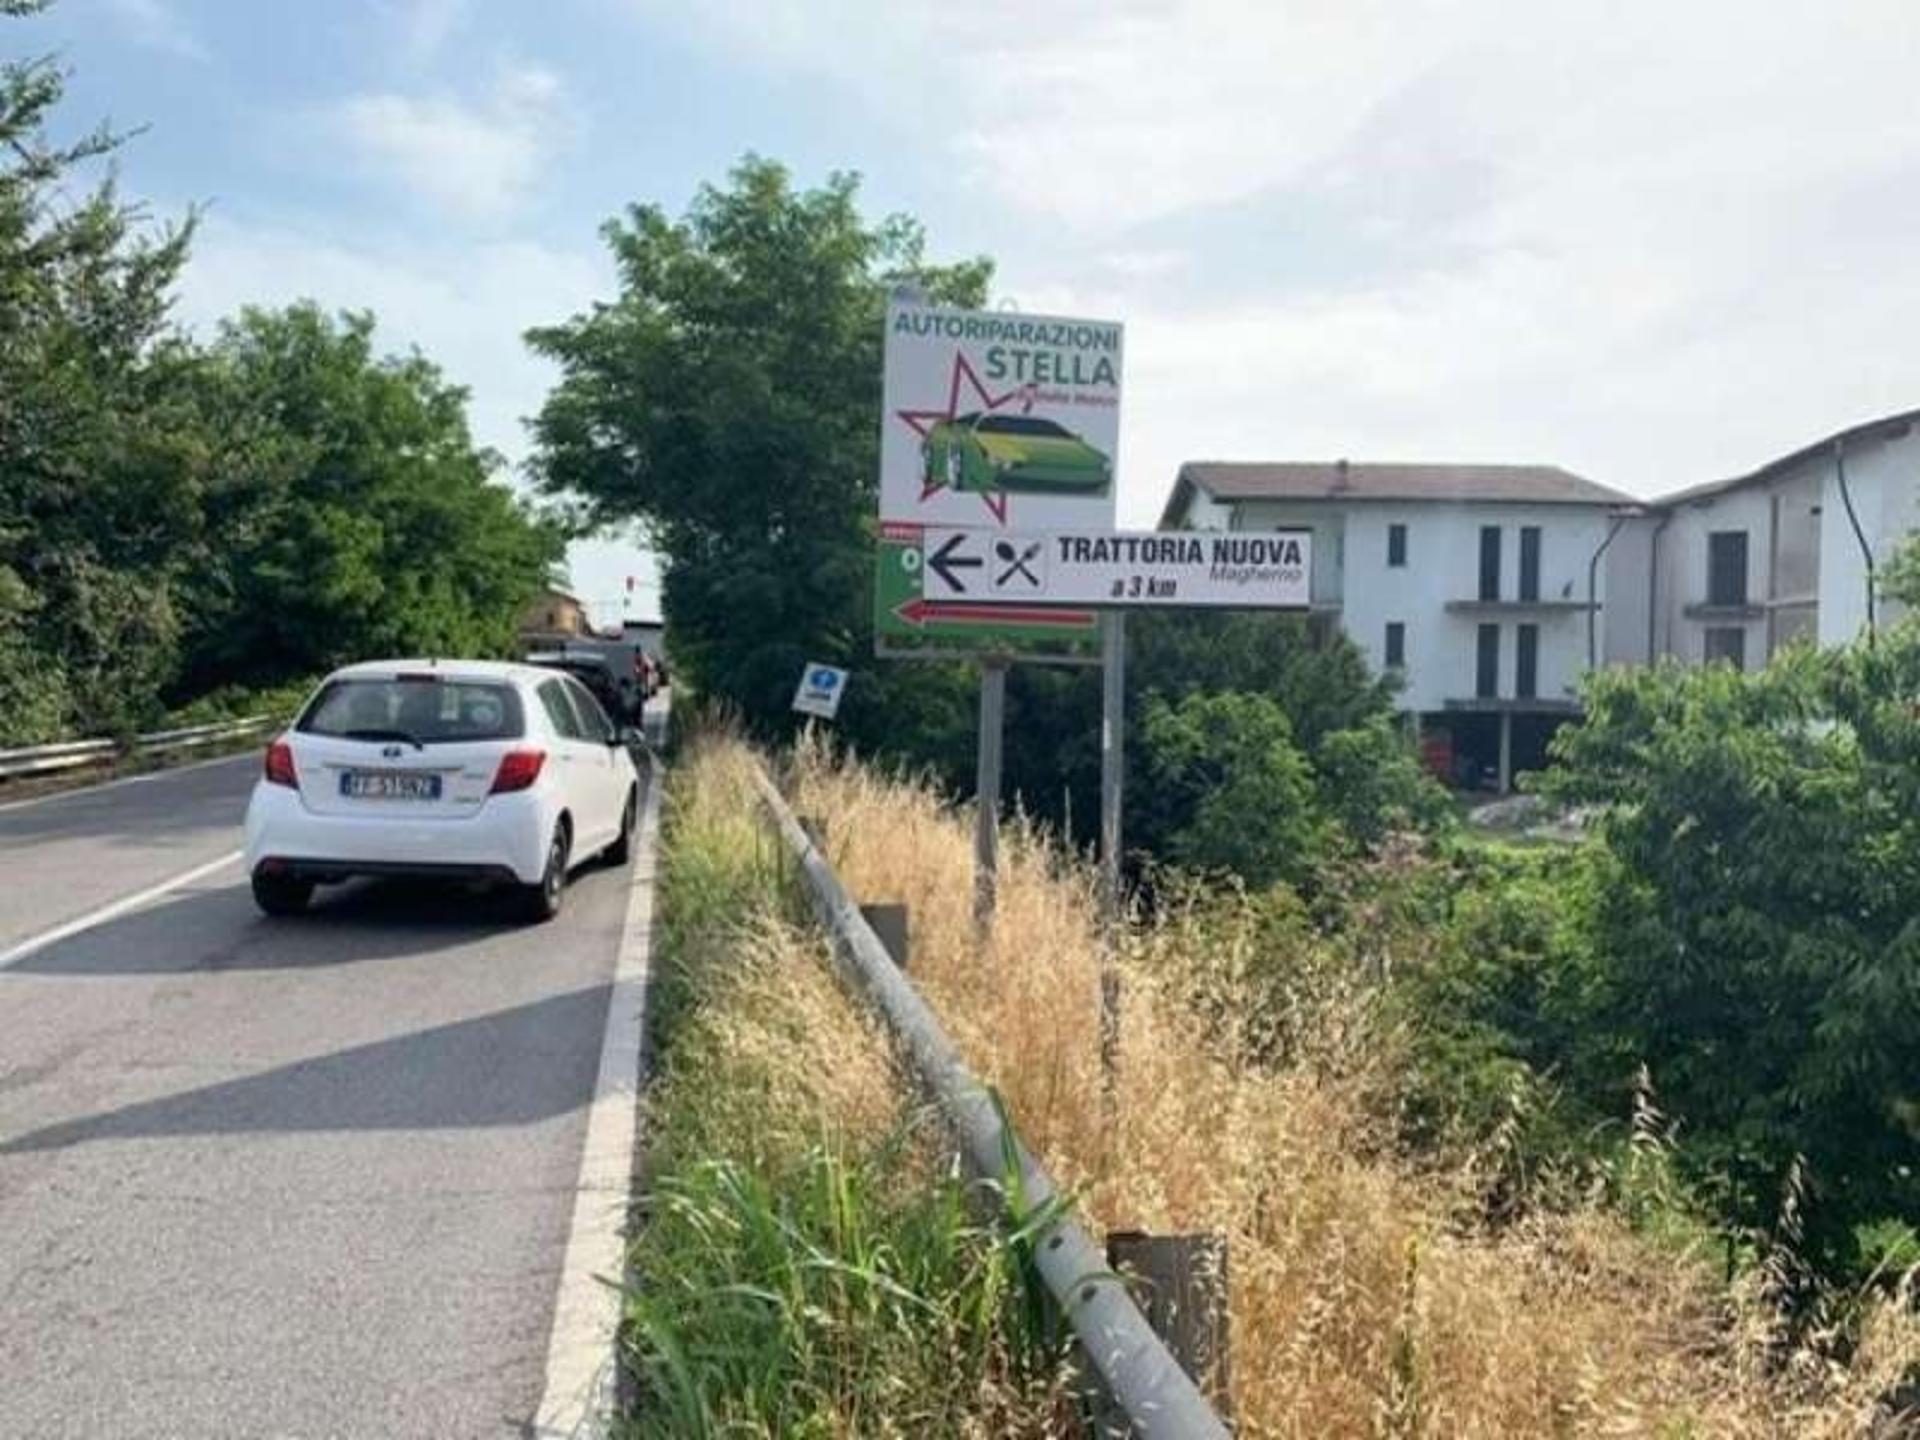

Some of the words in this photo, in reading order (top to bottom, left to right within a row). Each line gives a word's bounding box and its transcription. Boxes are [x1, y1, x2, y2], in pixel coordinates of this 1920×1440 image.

[895, 313, 1118, 350] AUTORIPARAZIONI
[986, 346, 1116, 386] STELLA
[1058, 536, 1203, 565] TRATTORIA
[1211, 538, 1302, 566] NUOVA
[1111, 579, 1124, 597] a
[1128, 576, 1143, 597] 3
[1146, 577, 1177, 597] km
